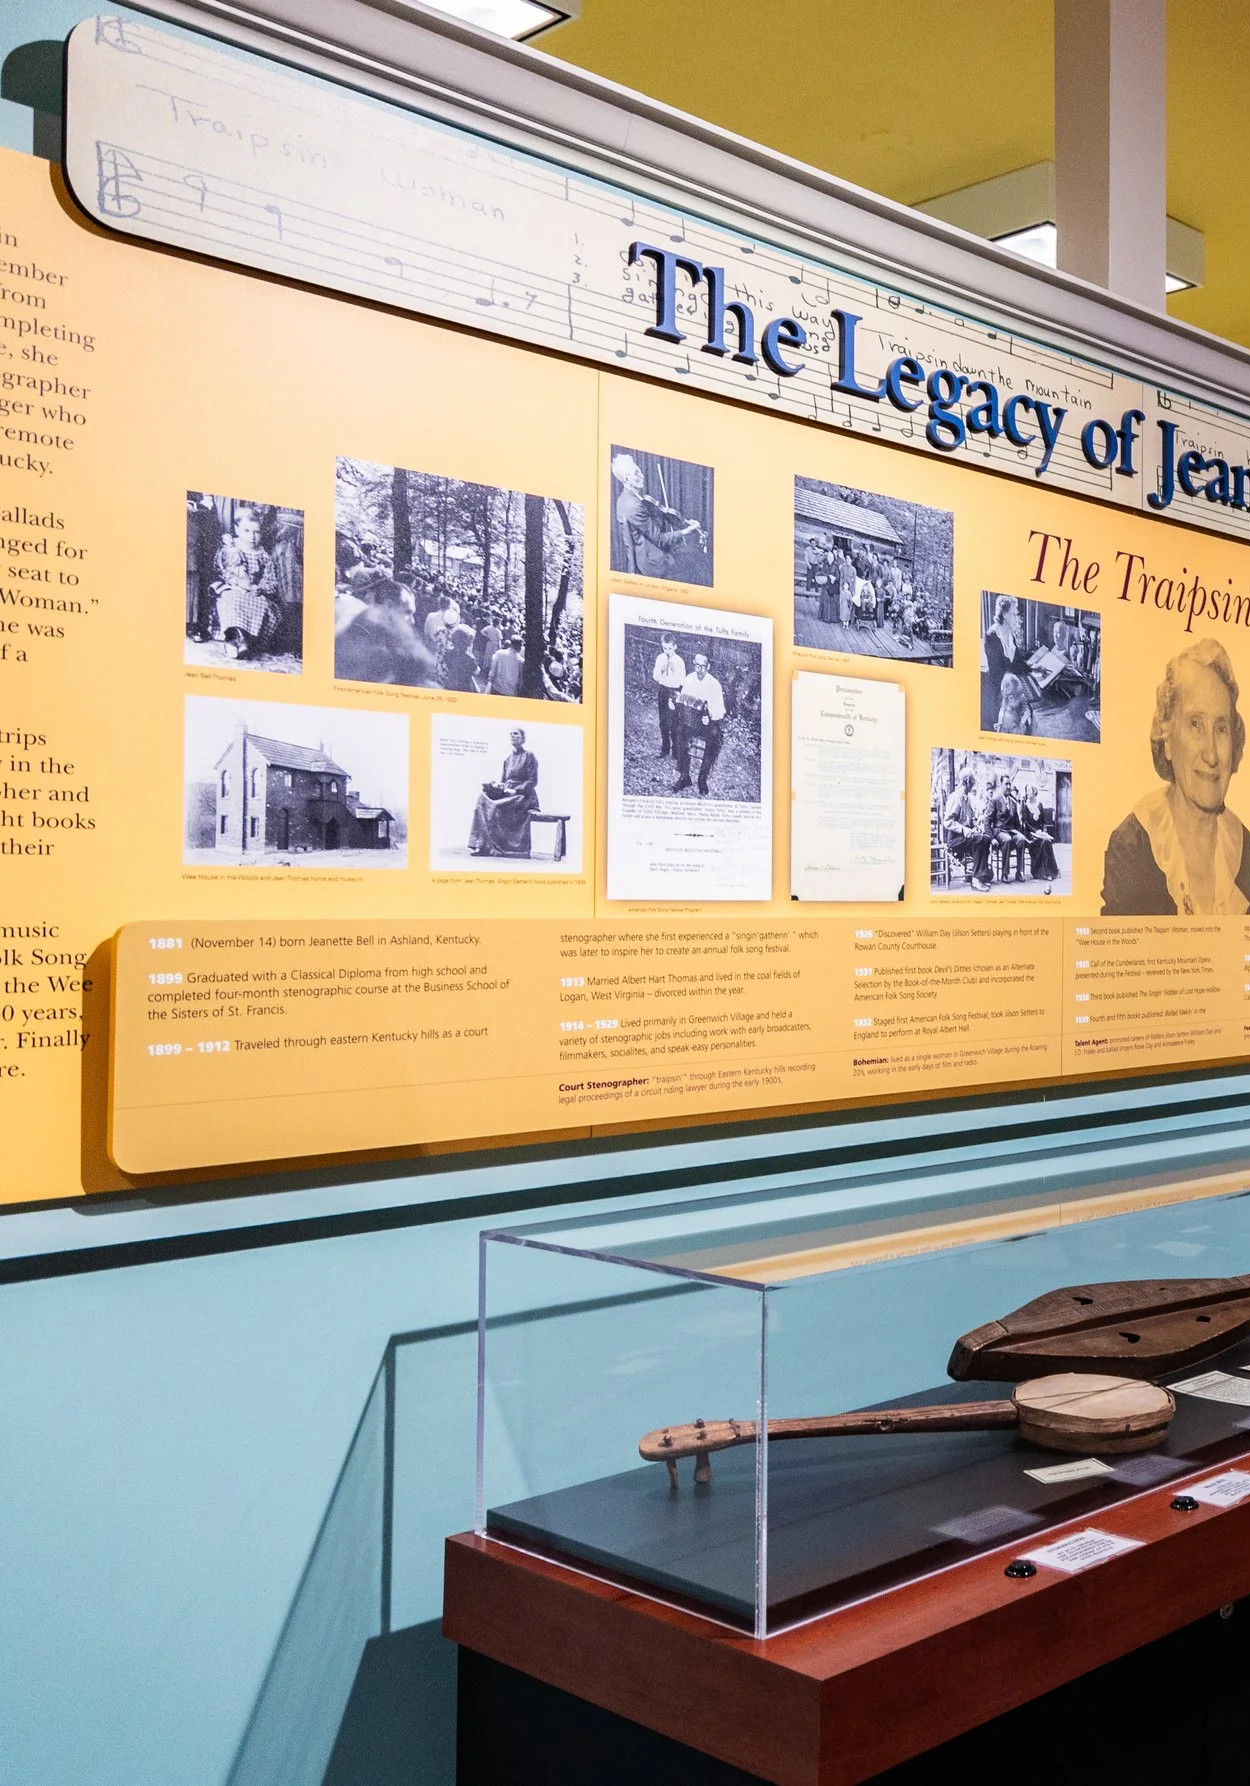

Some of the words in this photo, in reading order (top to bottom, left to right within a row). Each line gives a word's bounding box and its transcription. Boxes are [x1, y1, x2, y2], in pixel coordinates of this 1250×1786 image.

[732, 283, 775, 312] this
[792, 305, 836, 341] way
[21, 345, 58, 366] she
[628, 241, 807, 378] The
[831, 308, 1068, 478] Legacy
[1081, 409, 1146, 477] of
[2, 371, 91, 399] grapher
[1026, 378, 1092, 410] mountain
[42, 404, 87, 425] who
[56, 540, 88, 560] for
[1028, 530, 1100, 594] The
[8, 565, 52, 583] seat
[59, 571, 80, 586] to
[27, 622, 65, 639] was
[639, 616, 657, 624] Fourth
[660, 619, 692, 628] Generation
[716, 627, 729, 635] Tufts
[731, 629, 749, 638] Family
[16, 649, 29, 662] a
[10, 755, 31, 773] in
[40, 757, 75, 775] the
[49, 786, 89, 802] and
[32, 811, 96, 829] books
[1, 838, 55, 855] their
[148, 936, 183, 950] 1881
[190, 936, 255, 950] (November
[259, 936, 277, 949] 14)
[279, 936, 306, 947] born
[308, 936, 354, 947] Jeanette
[356, 935, 375, 946] Bell
[378, 936, 387, 946] in
[389, 935, 433, 946] Ashland,
[437, 935, 481, 946] Kentucky.
[31, 949, 87, 970] Song
[4, 977, 40, 993] the
[48, 975, 93, 992] Wee
[148, 973, 183, 985] 1899
[186, 971, 249, 984] Graduated
[252, 970, 277, 982] with
[280, 972, 287, 981] a
[290, 969, 335, 981] Classical
[338, 968, 382, 980] Diploma
[384, 967, 409, 978] from
[411, 966, 433, 979] high
[436, 965, 467, 976] school
[469, 965, 488, 975] and
[560, 976, 585, 987] 1913
[586, 976, 620, 986] Married
[621, 975, 647, 985] Albert
[648, 975, 666, 984] Hart
[667, 973, 698, 983] Thomas
[699, 973, 714, 982] and
[715, 972, 733, 981] lived
[743, 972, 756, 981] the
[756, 971, 772, 980] coal
[773, 969, 792, 979] fields
[792, 969, 801, 979] of
[148, 989, 210, 1004] completed
[215, 987, 279, 1000] four-month
[283, 985, 352, 998] stenographic
[355, 986, 388, 995] course
[392, 984, 401, 993] at
[405, 983, 420, 993] the
[424, 982, 463, 992] Business
[467, 980, 497, 990] School
[500, 979, 510, 989] of
[22, 1007, 84, 1027] years,
[148, 1009, 167, 1020] the
[170, 1008, 208, 1019] Sisters
[212, 1006, 224, 1017] of
[228, 1006, 242, 1016] St.
[247, 1004, 287, 1015] Francis.
[17, 1029, 90, 1052] Finally
[148, 1043, 182, 1056] 1899
[198, 1041, 230, 1053] 1912
[233, 1037, 280, 1051] Traveled
[283, 1035, 327, 1049] through
[330, 1034, 369, 1046] eastern
[371, 1030, 419, 1043] Kentucky
[420, 1028, 440, 1040] hills
[441, 1030, 453, 1039] as
[454, 1029, 461, 1038] a
[463, 1027, 488, 1038] court
[853, 1057, 890, 1067] Bohemian:
[559, 1081, 585, 1091] Court
[587, 1077, 650, 1089] Stenographer:
